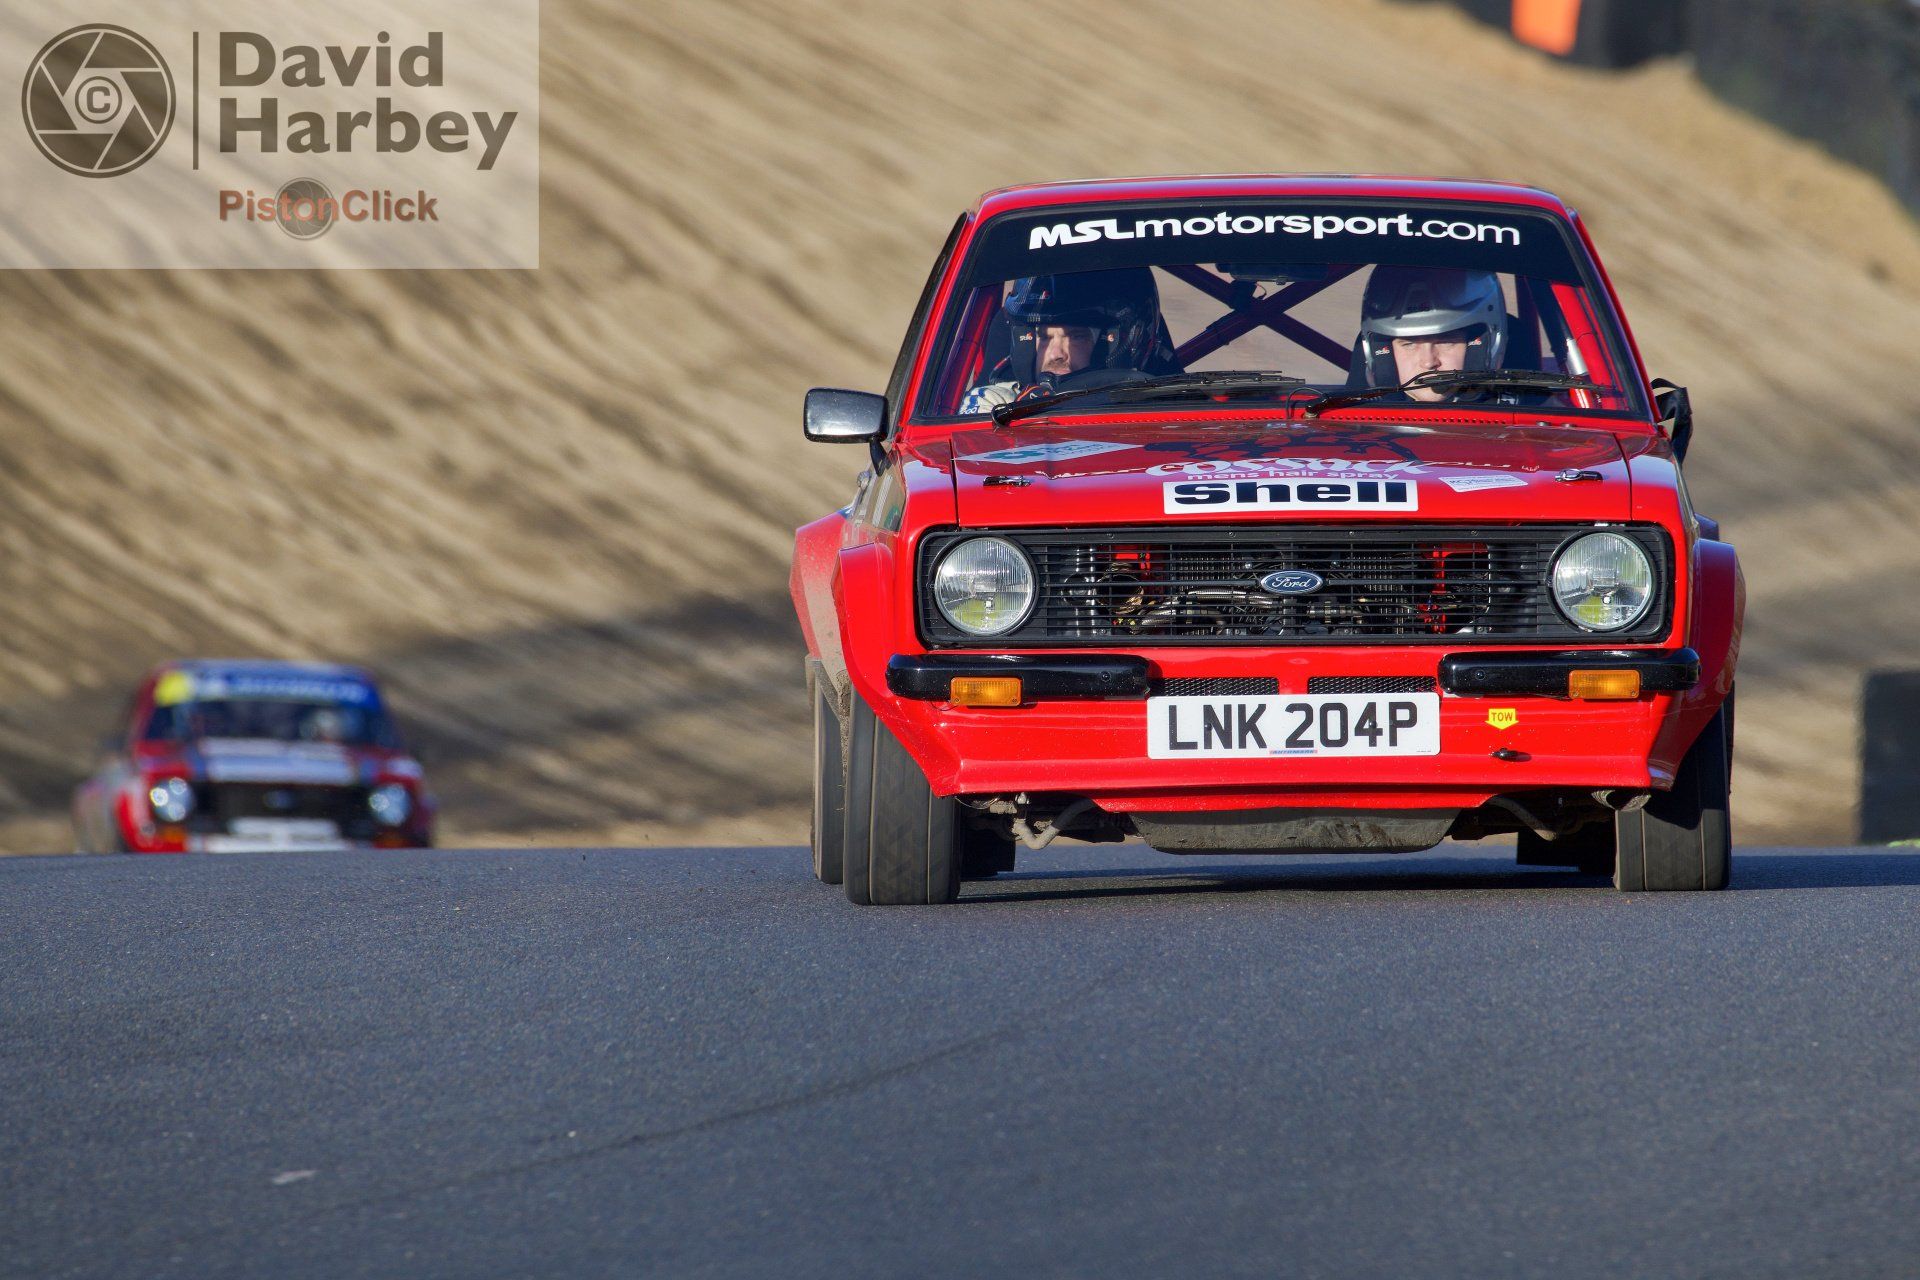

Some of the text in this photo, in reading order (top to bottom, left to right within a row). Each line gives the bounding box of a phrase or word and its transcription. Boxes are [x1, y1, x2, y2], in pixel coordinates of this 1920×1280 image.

[1028, 211, 1520, 249] MSLmotorsport.com
[1187, 469, 1399, 480] mens hair spray
[1174, 481, 1408, 504] Shell
[1271, 576, 1312, 588] Ford
[1491, 712, 1513, 721] TOW
[1168, 701, 1418, 750] LNK 204P
